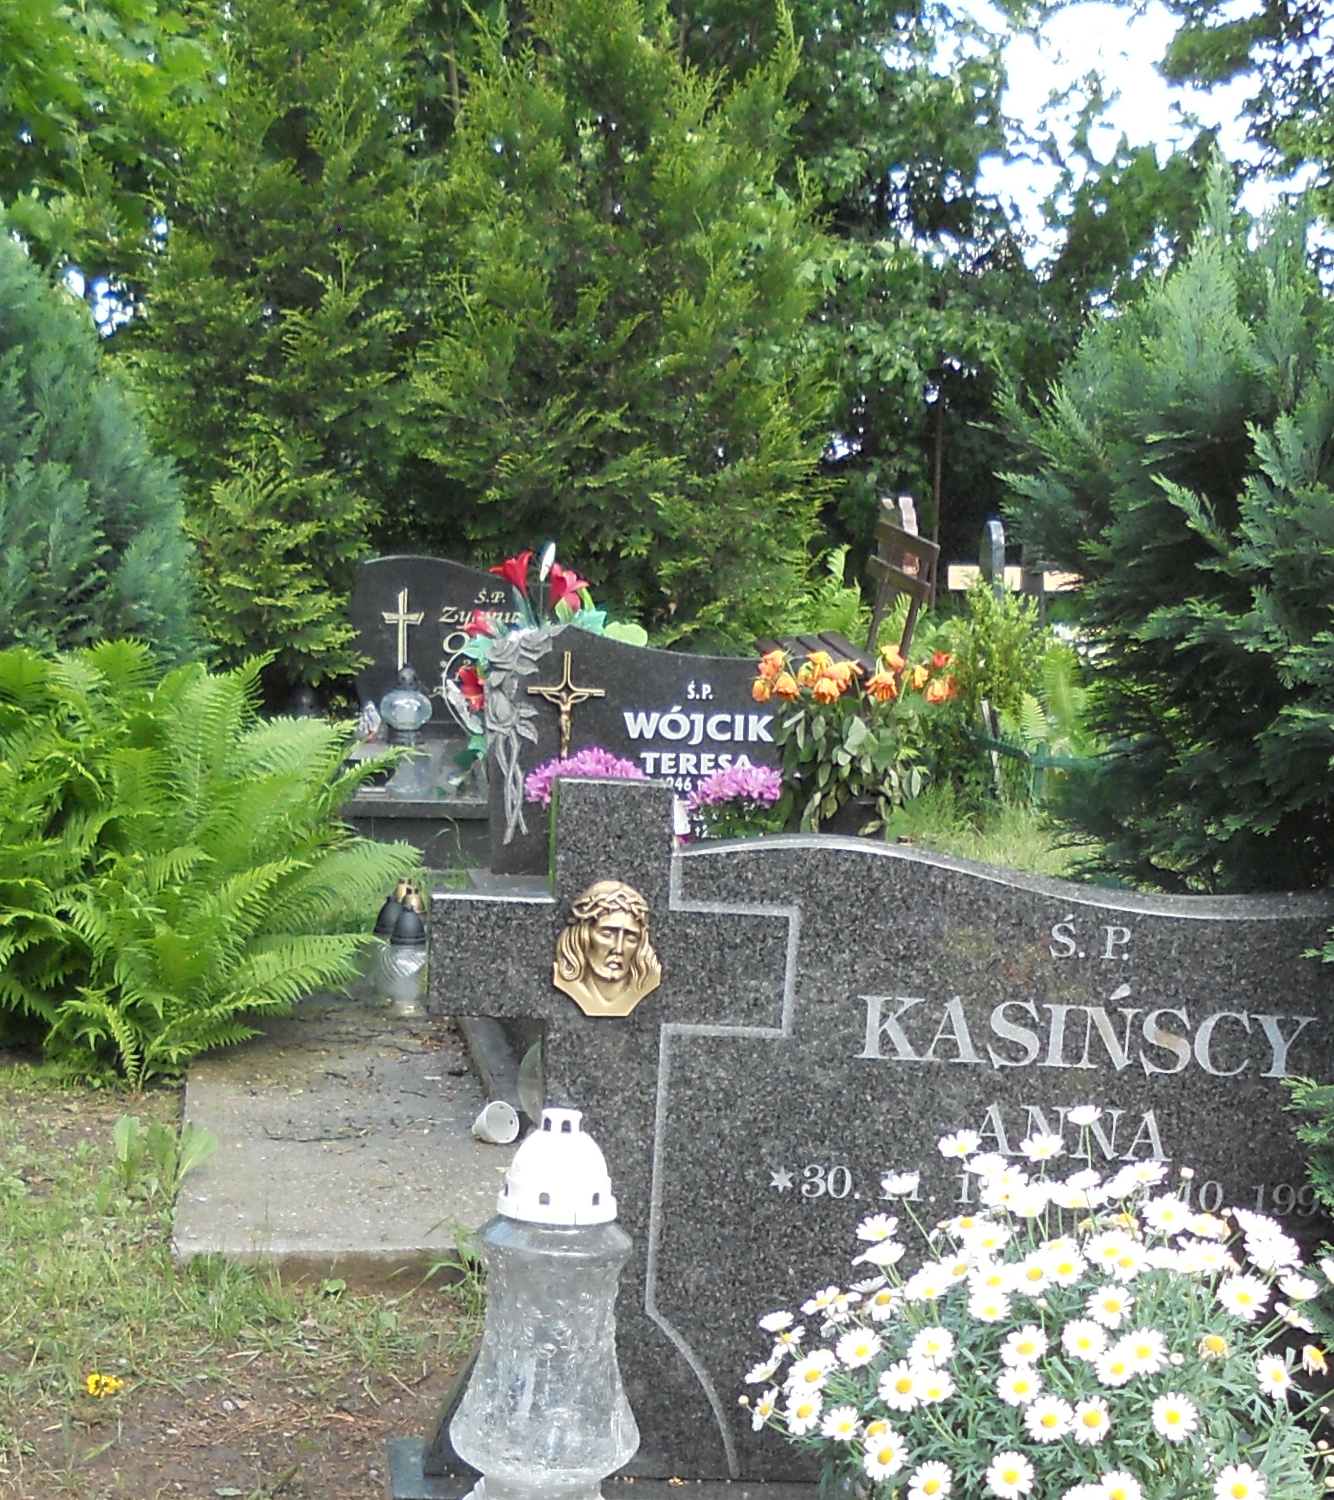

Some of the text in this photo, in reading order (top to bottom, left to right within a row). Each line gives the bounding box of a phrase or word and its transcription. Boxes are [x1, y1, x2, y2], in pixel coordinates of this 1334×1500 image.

[687, 680, 714, 700] Ś.P.
[623, 705, 774, 745] WÓJCIK
[640, 752, 753, 775] TERESA
[854, 983, 1318, 1079] KASIŃSCY
[969, 1102, 1173, 1162] ANNA
[1251, 1183, 1331, 1218] 199
